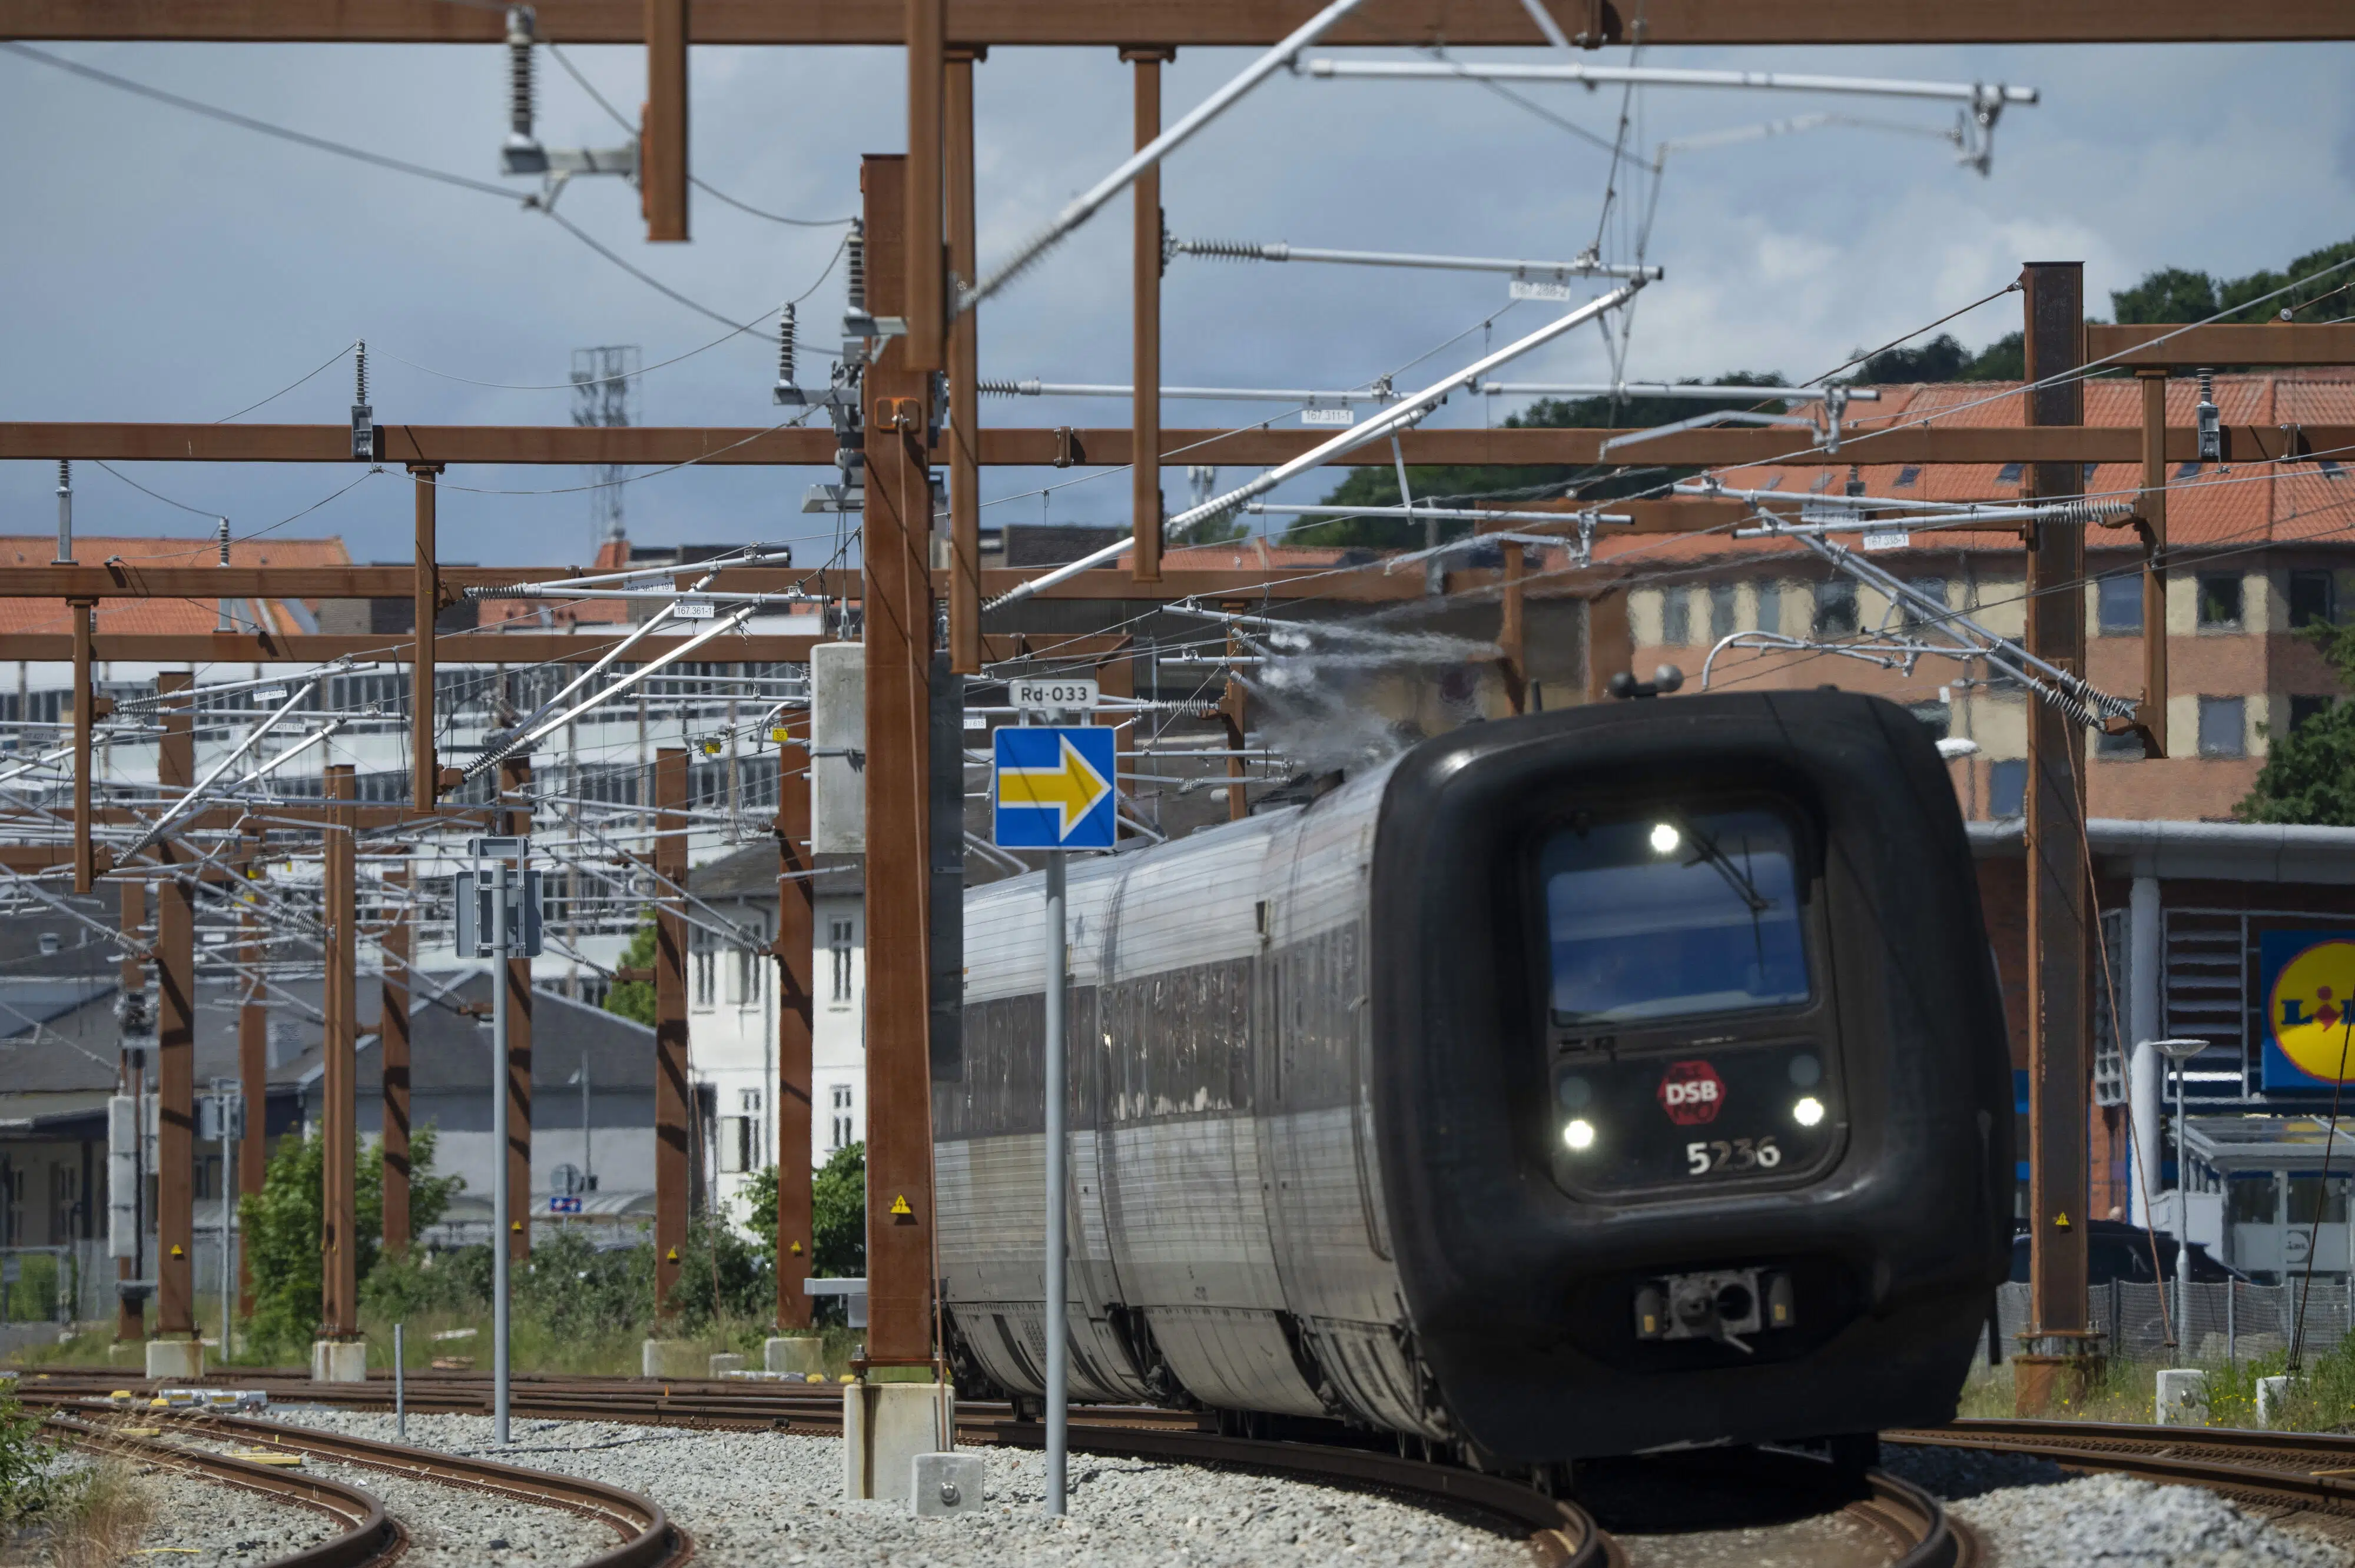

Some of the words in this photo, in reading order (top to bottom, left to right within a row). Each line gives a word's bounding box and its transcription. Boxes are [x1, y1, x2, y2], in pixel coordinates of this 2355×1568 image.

[1021, 687, 1087, 701] Rd-033
[1666, 1079, 1718, 1105] DSB
[1686, 1135, 1780, 1175] 5236
